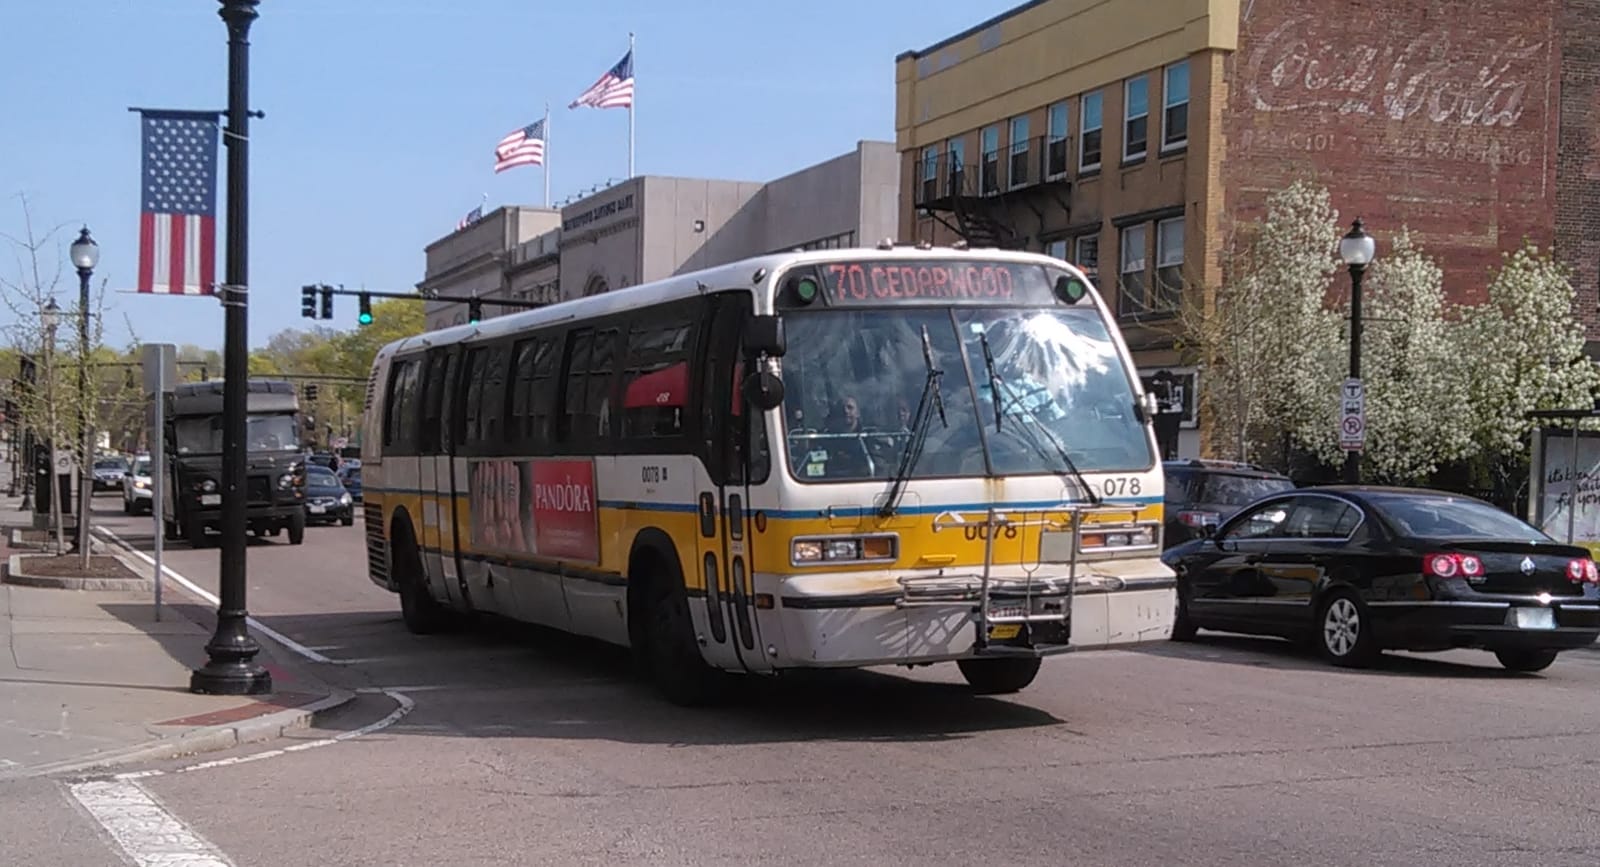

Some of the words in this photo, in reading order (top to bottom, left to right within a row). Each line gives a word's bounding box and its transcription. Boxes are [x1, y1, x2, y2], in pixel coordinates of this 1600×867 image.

[829, 264, 867, 300] 70
[871, 265, 1013, 299] CEDARWOOD
[1346, 385, 1360, 396] T
[642, 465, 660, 484] 0078
[1565, 466, 1592, 481] ben
[1103, 477, 1142, 497] 078
